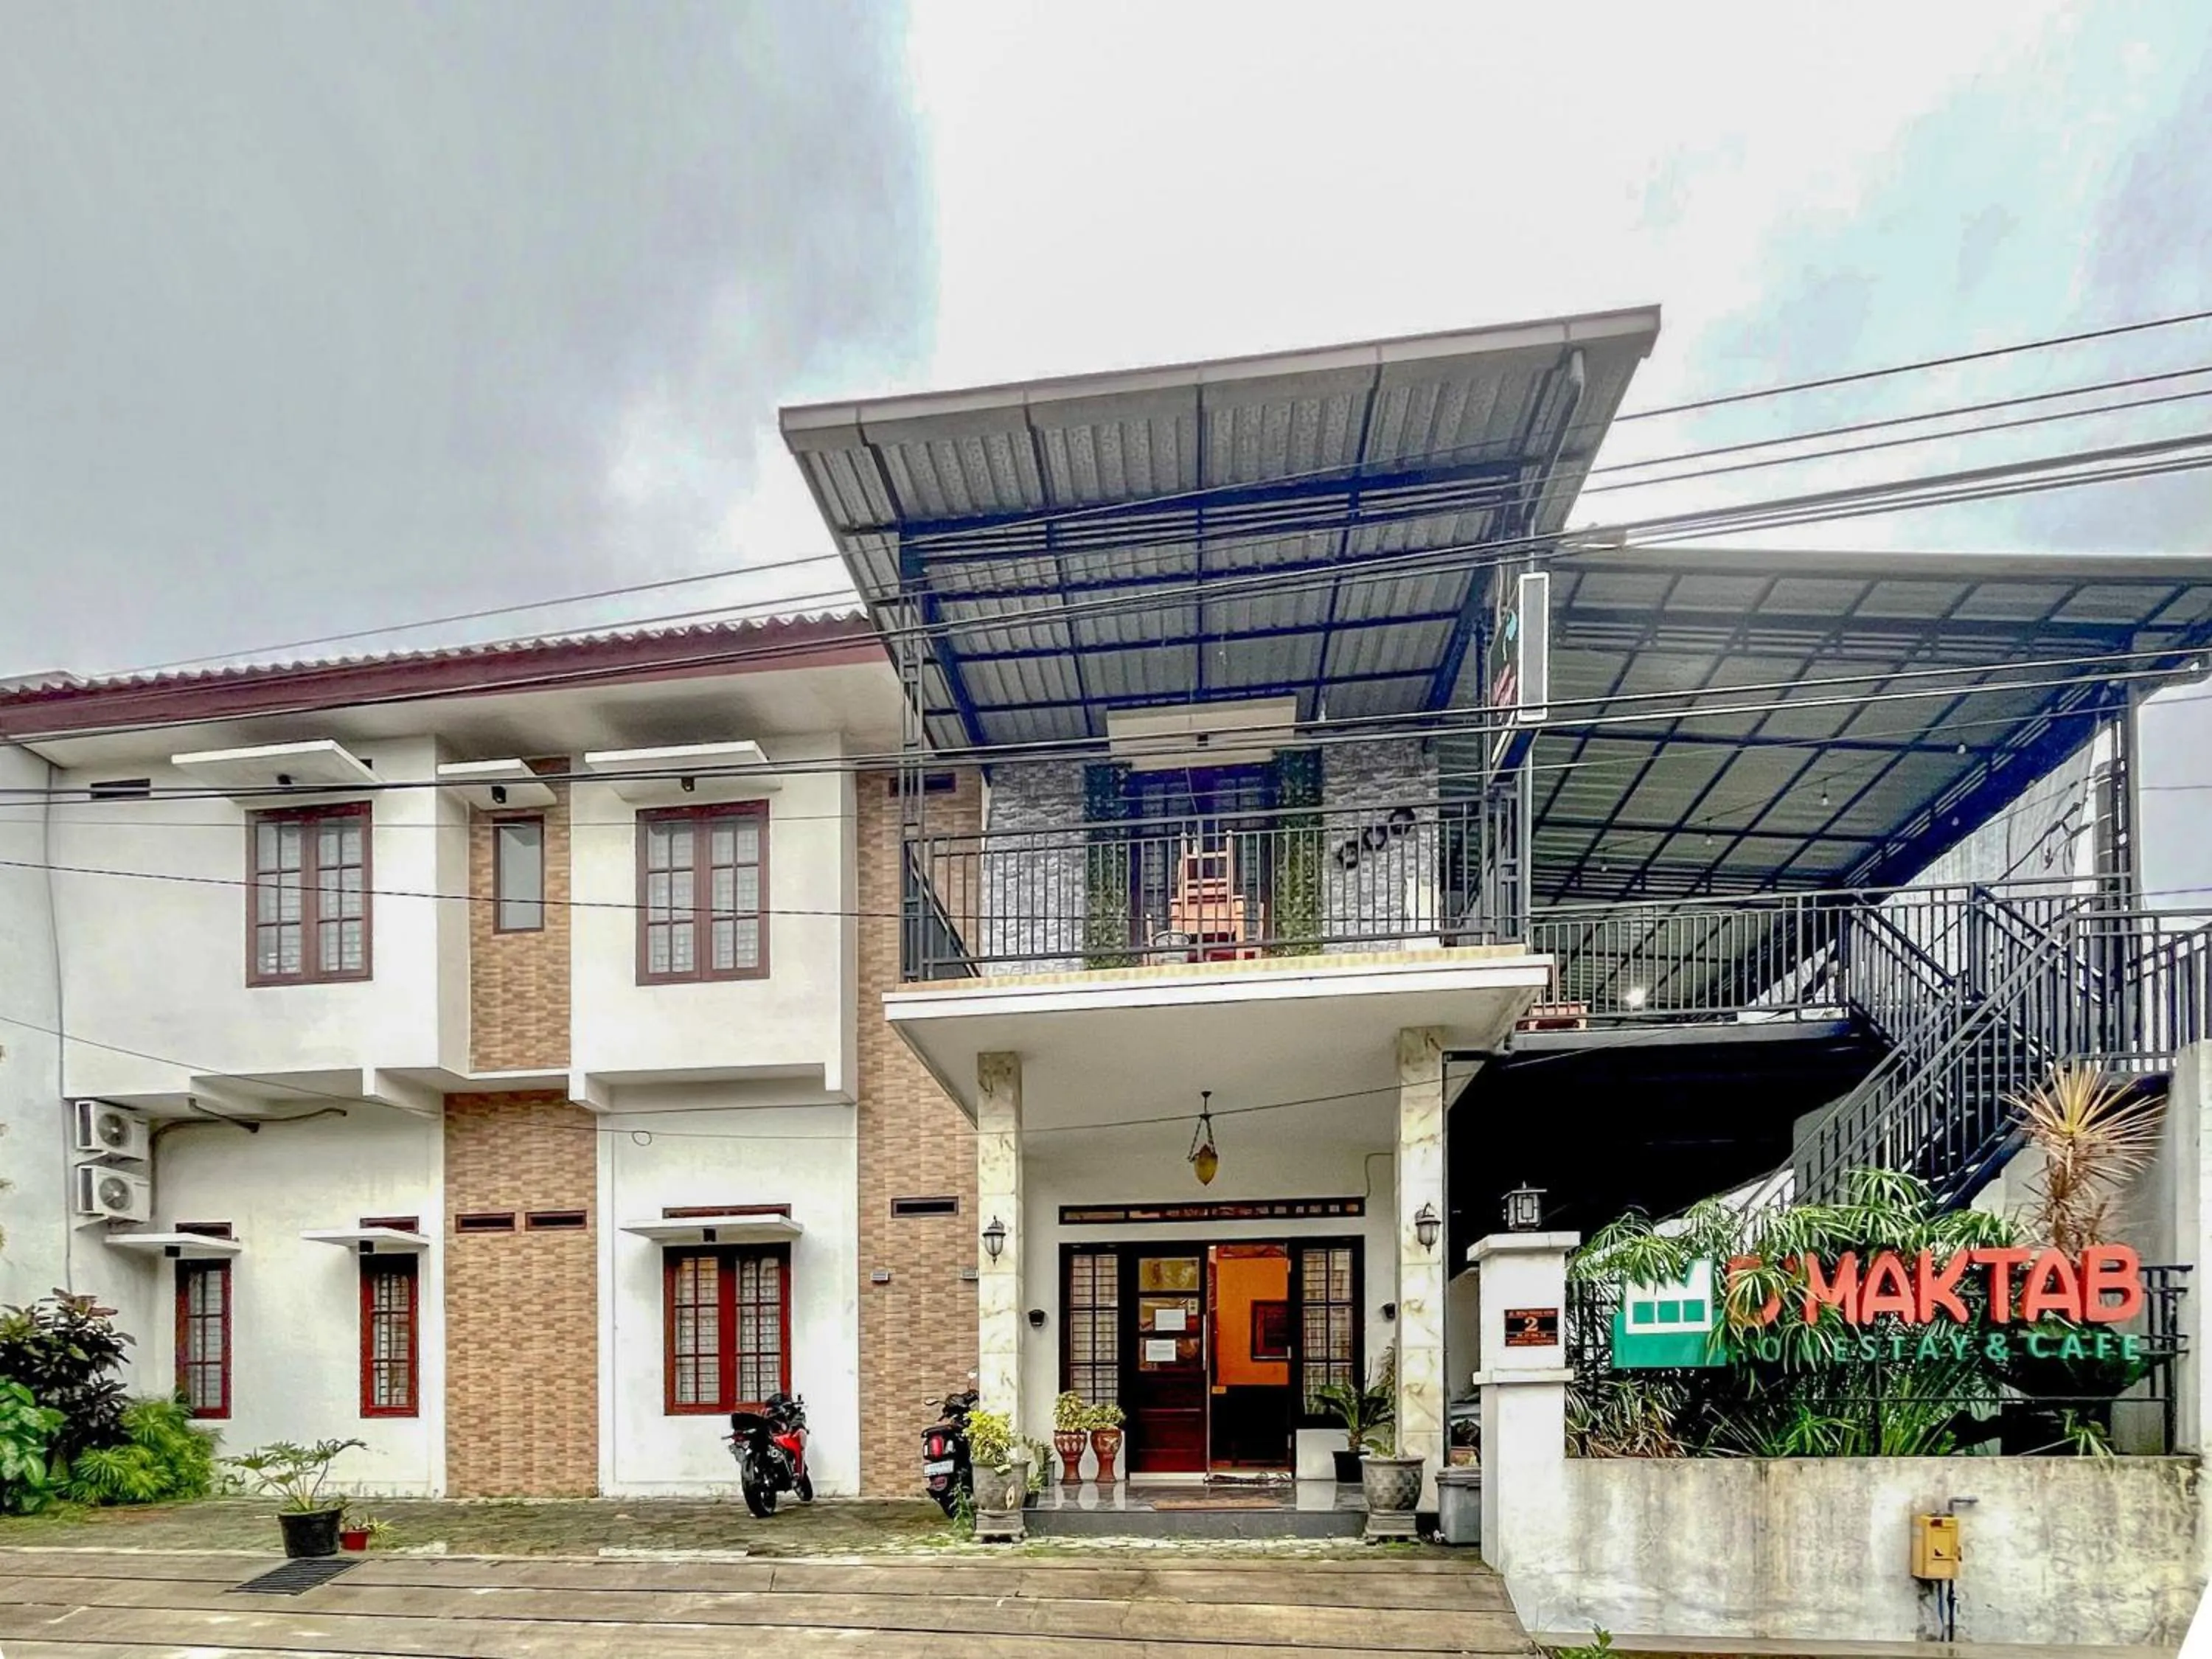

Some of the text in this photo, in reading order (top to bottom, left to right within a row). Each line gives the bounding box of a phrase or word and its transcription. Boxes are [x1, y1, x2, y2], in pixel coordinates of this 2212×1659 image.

[1524, 1316, 1539, 1332] 2
[1731, 1332, 2141, 1362] OESTAY & CAFE
